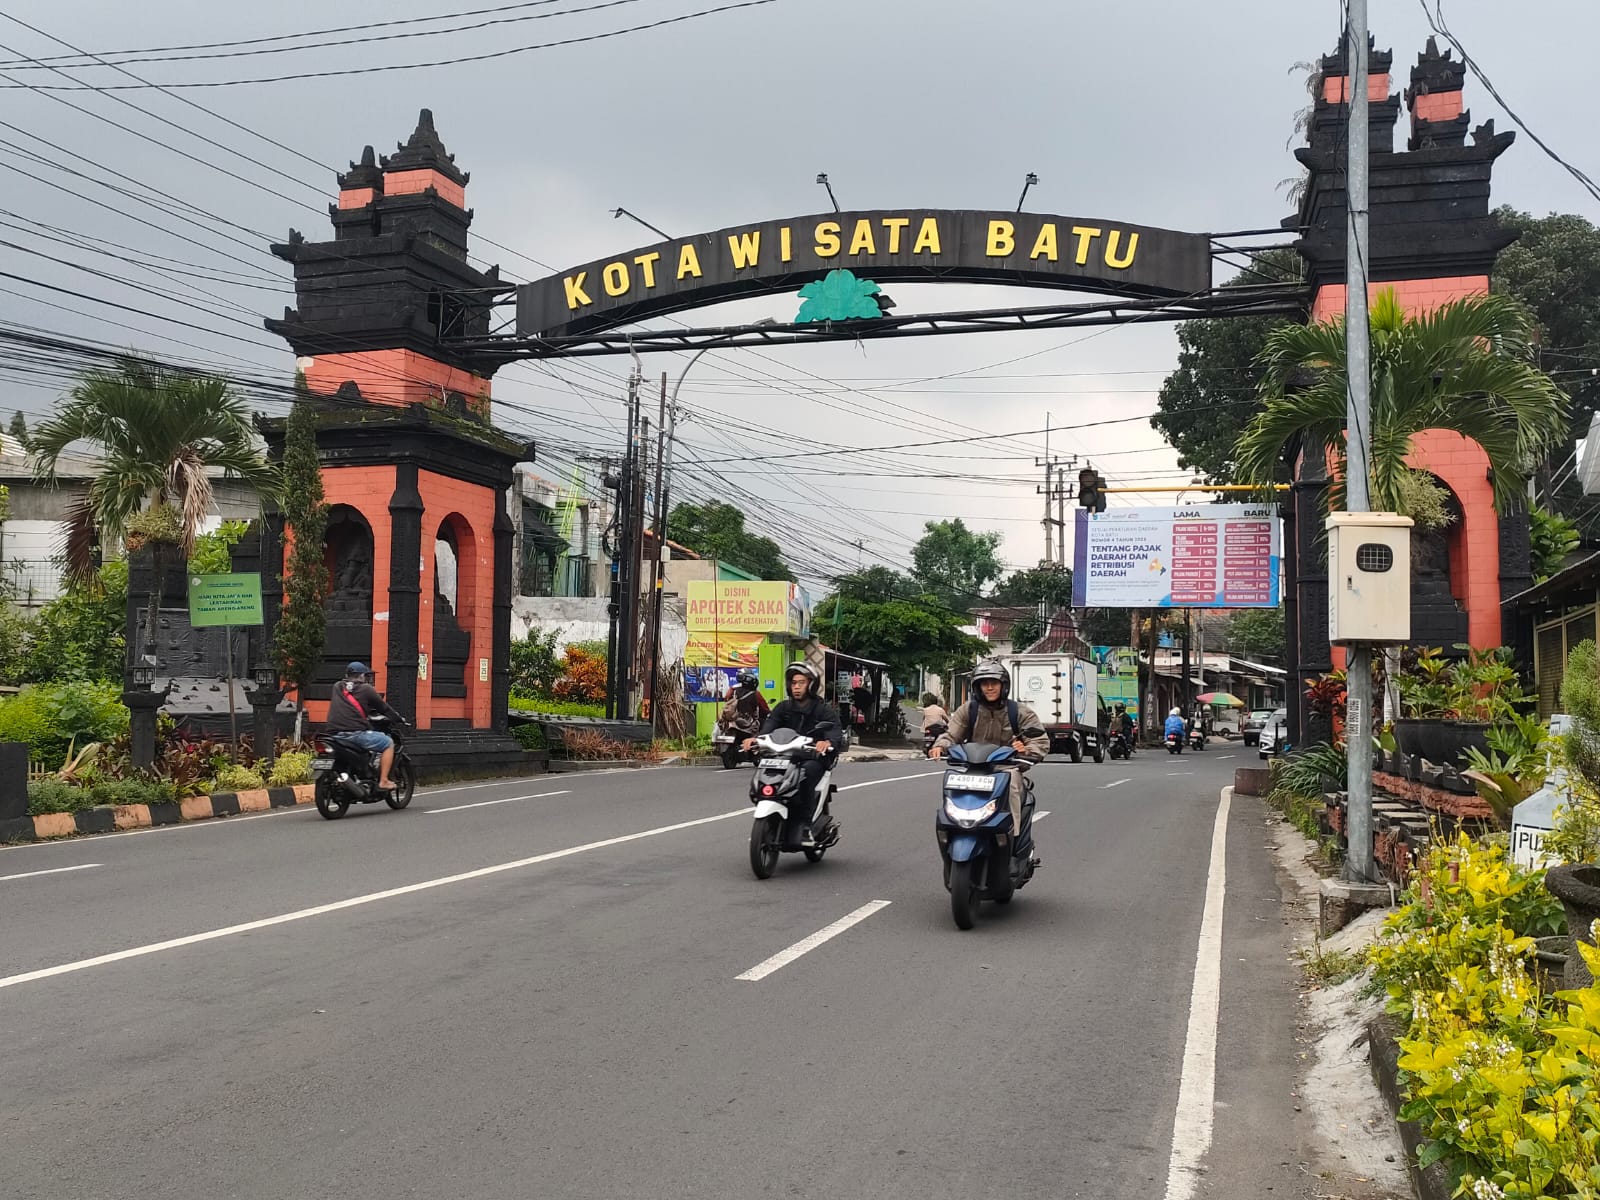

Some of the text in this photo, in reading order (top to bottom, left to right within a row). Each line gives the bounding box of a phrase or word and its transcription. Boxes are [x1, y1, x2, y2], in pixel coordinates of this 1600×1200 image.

[563, 217, 1139, 310] KOTA WISATA BATU
[724, 587, 750, 597] DISINI
[690, 600, 784, 615] APOTEK SAKA
